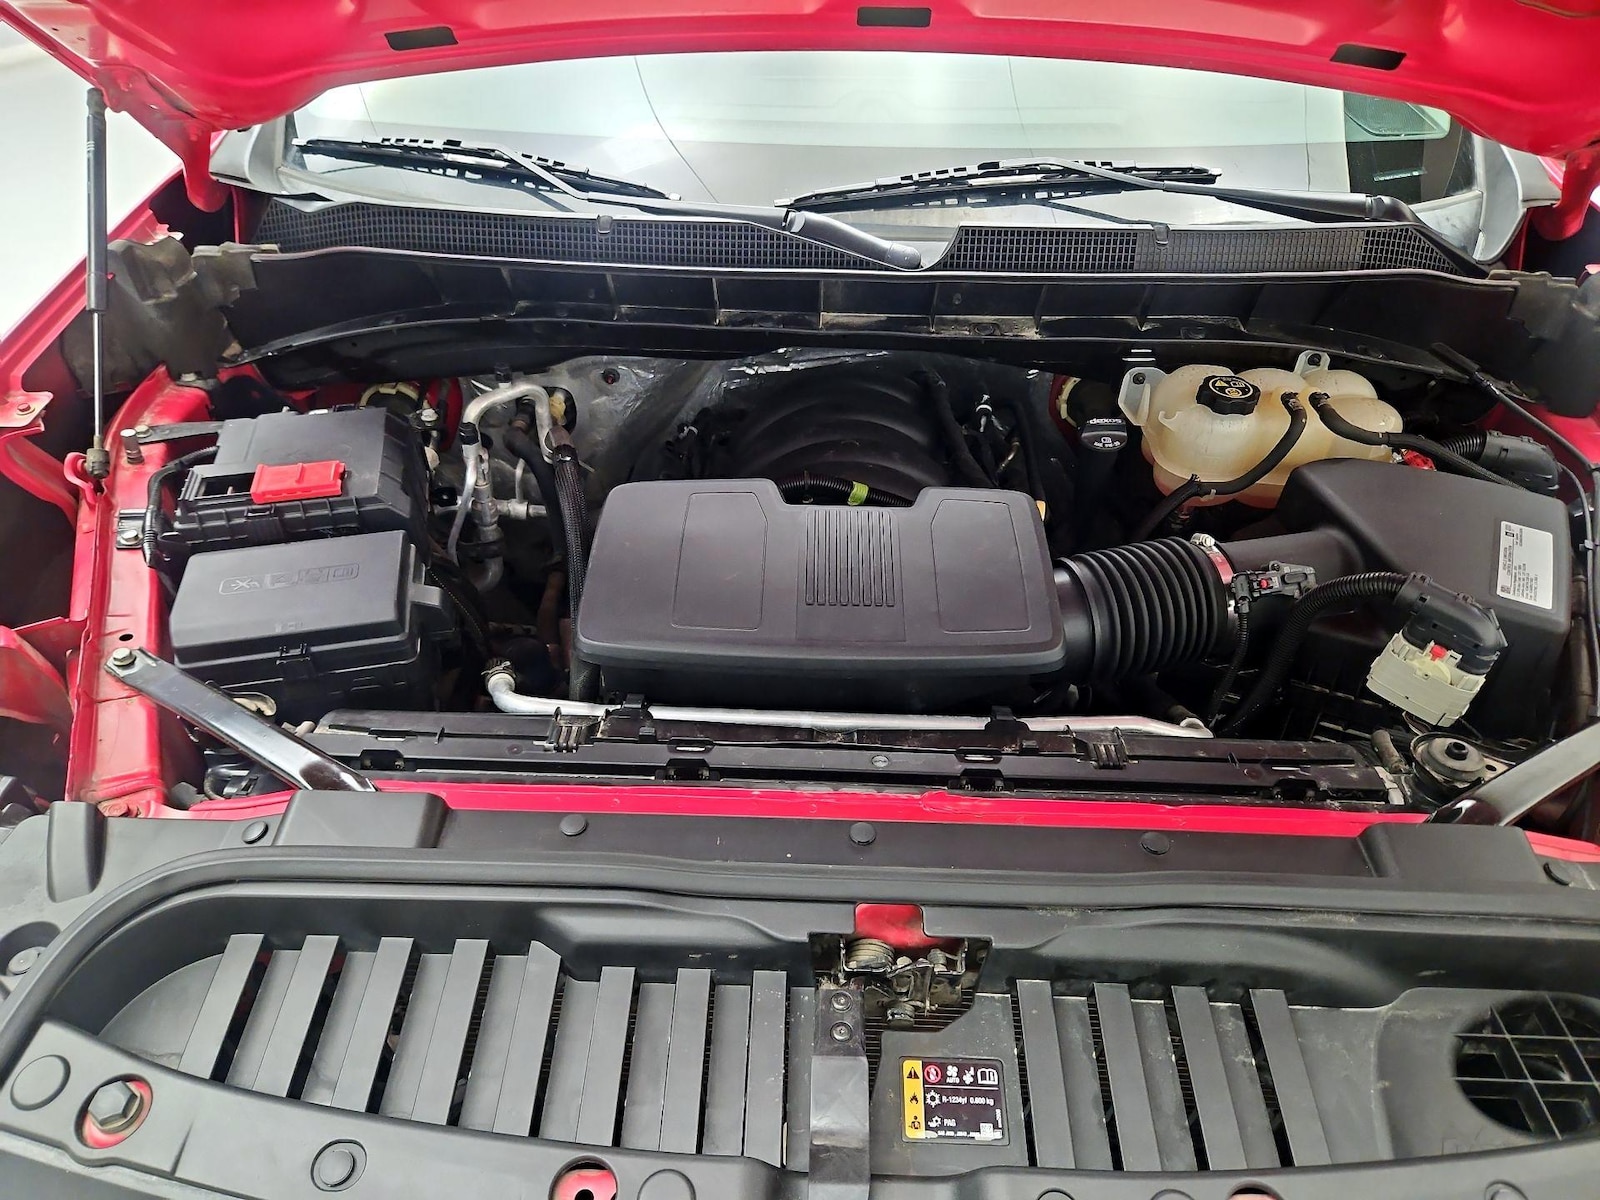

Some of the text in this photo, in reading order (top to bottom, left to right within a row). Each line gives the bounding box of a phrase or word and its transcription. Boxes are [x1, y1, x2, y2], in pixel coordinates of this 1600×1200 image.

[941, 1095, 968, 1105] R-1234yf
[986, 1097, 995, 1106] kg
[943, 1118, 957, 1127] PAG
